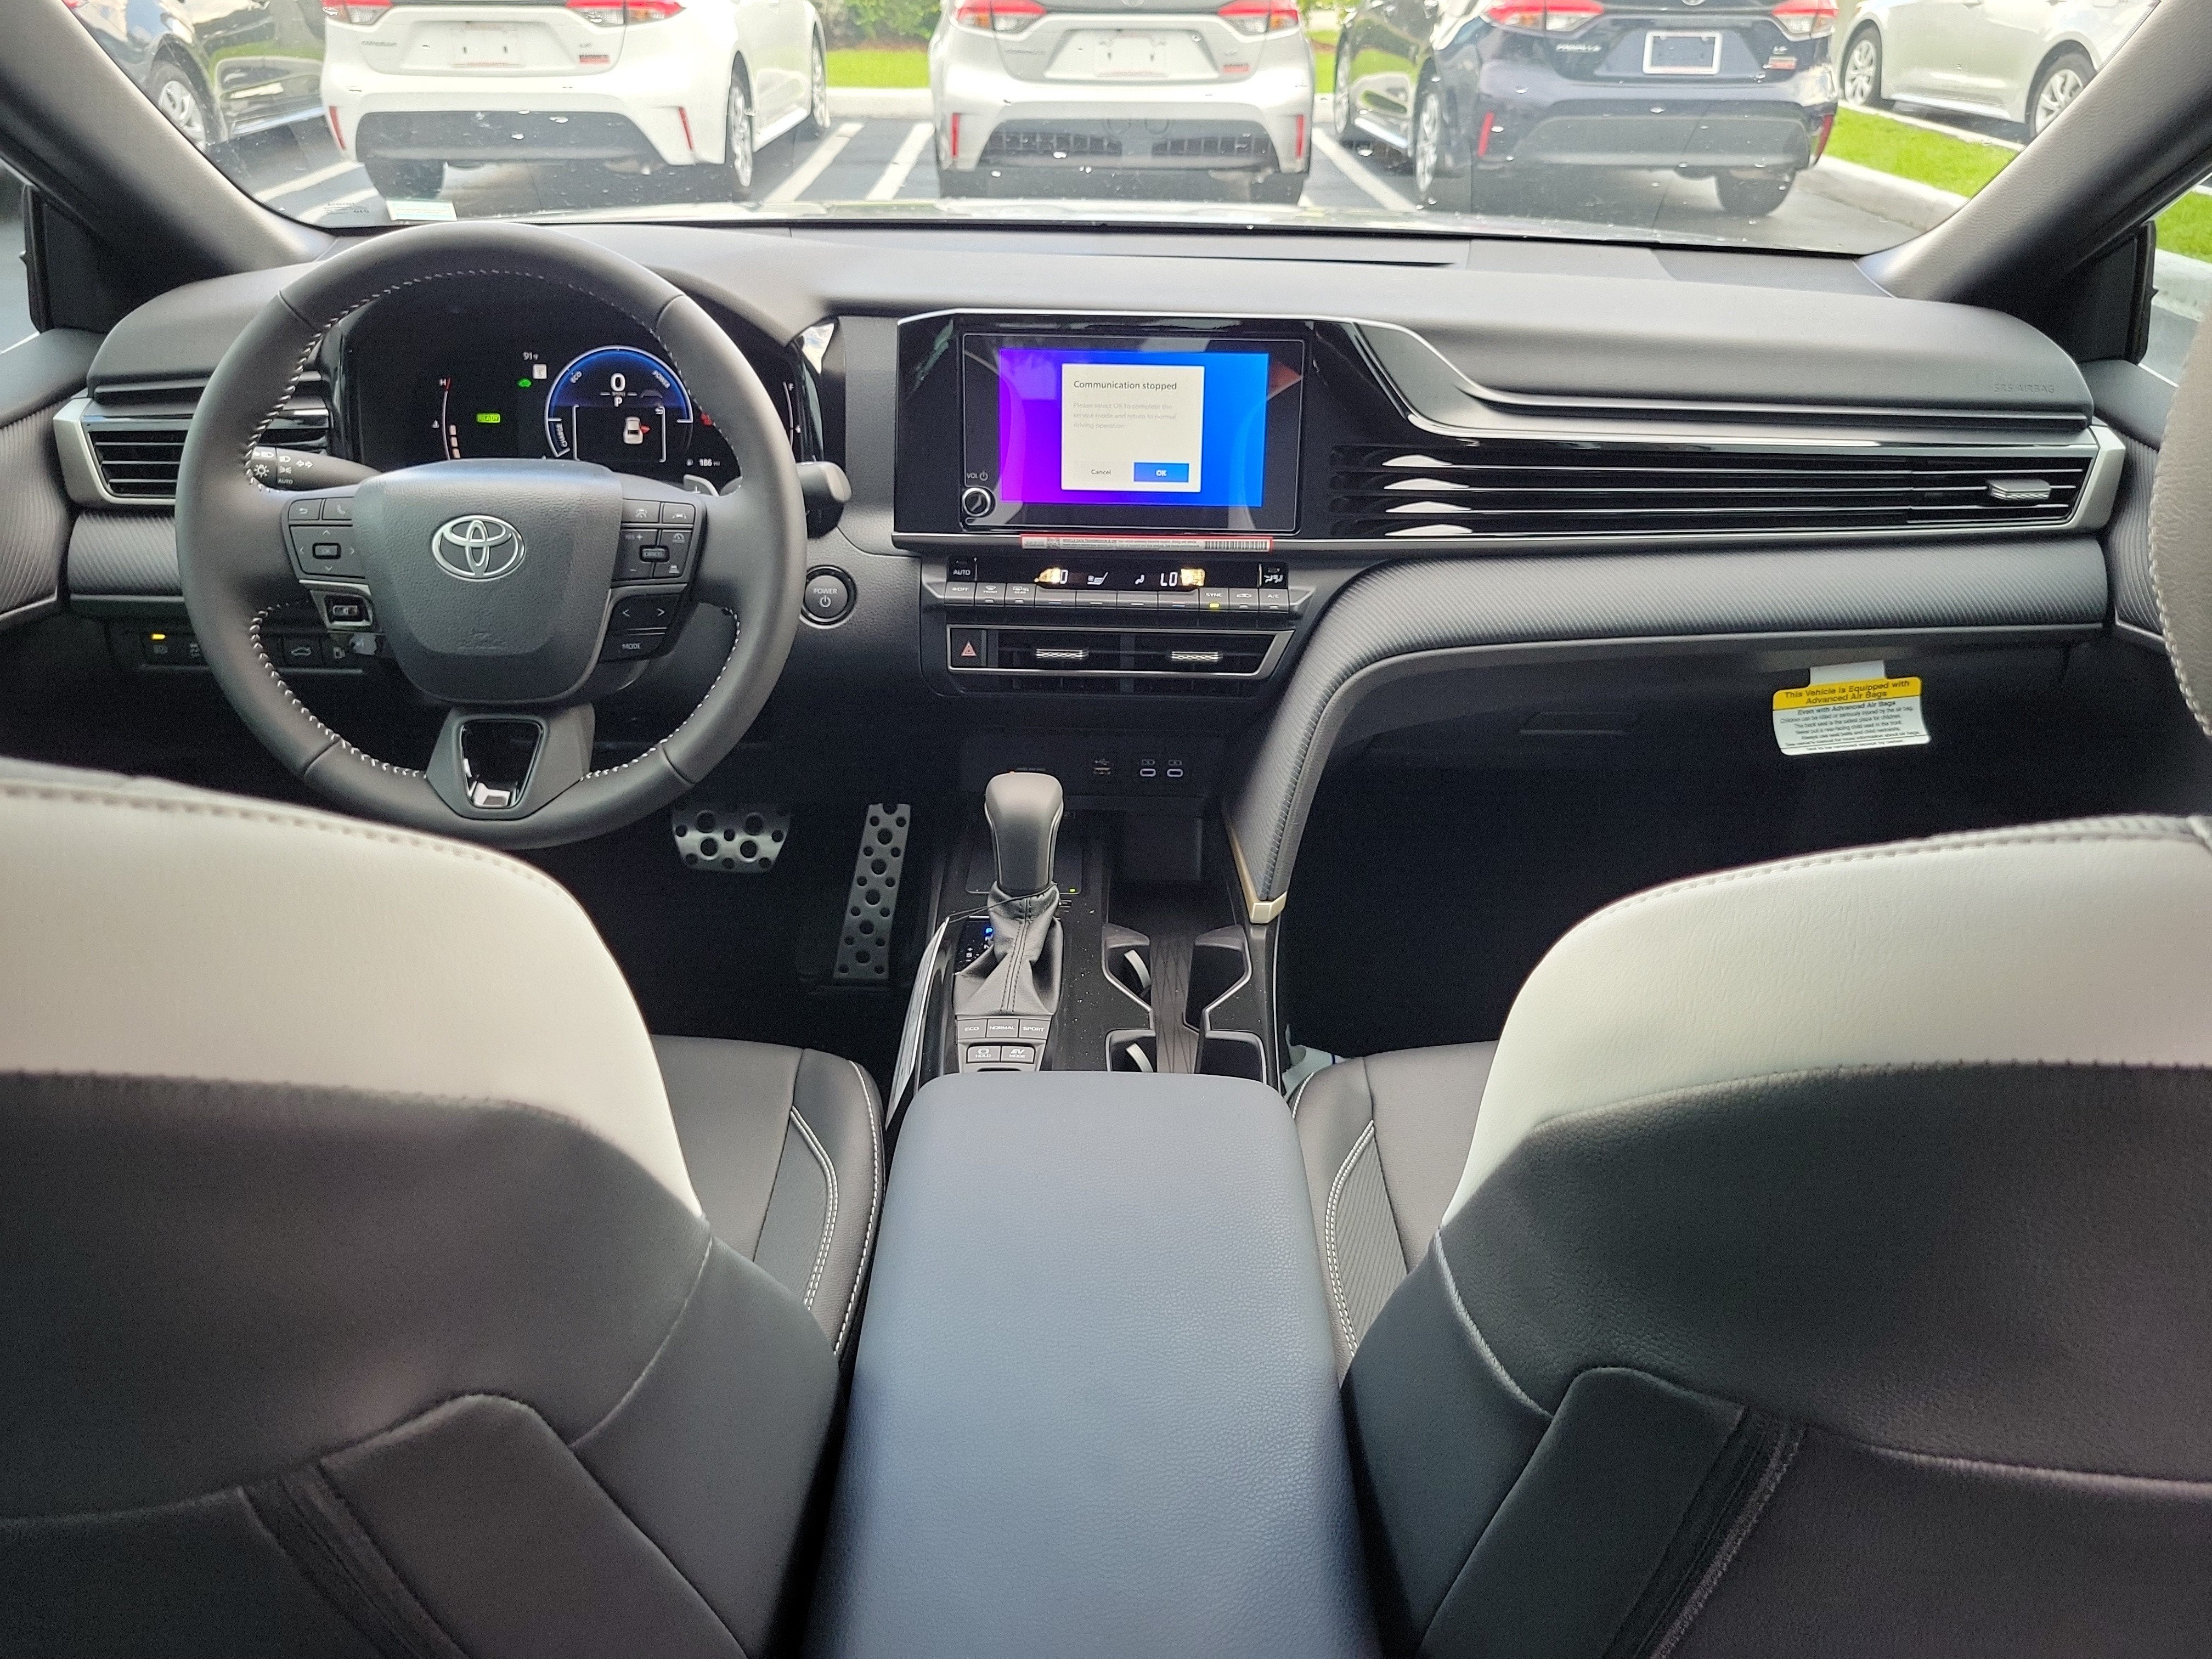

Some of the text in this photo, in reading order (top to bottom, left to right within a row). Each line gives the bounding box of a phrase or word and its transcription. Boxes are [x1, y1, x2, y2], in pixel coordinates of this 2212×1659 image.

[1074, 380, 1177, 392] Communication stopped
[614, 396, 623, 408] P
[1160, 572, 1178, 587] LO
[1805, 689, 1836, 697] Vehicle
[1848, 682, 1889, 694] Equipped
[1891, 680, 1910, 688] with
[1806, 694, 1849, 704] Advanced
[1866, 691, 1887, 699] Bags
